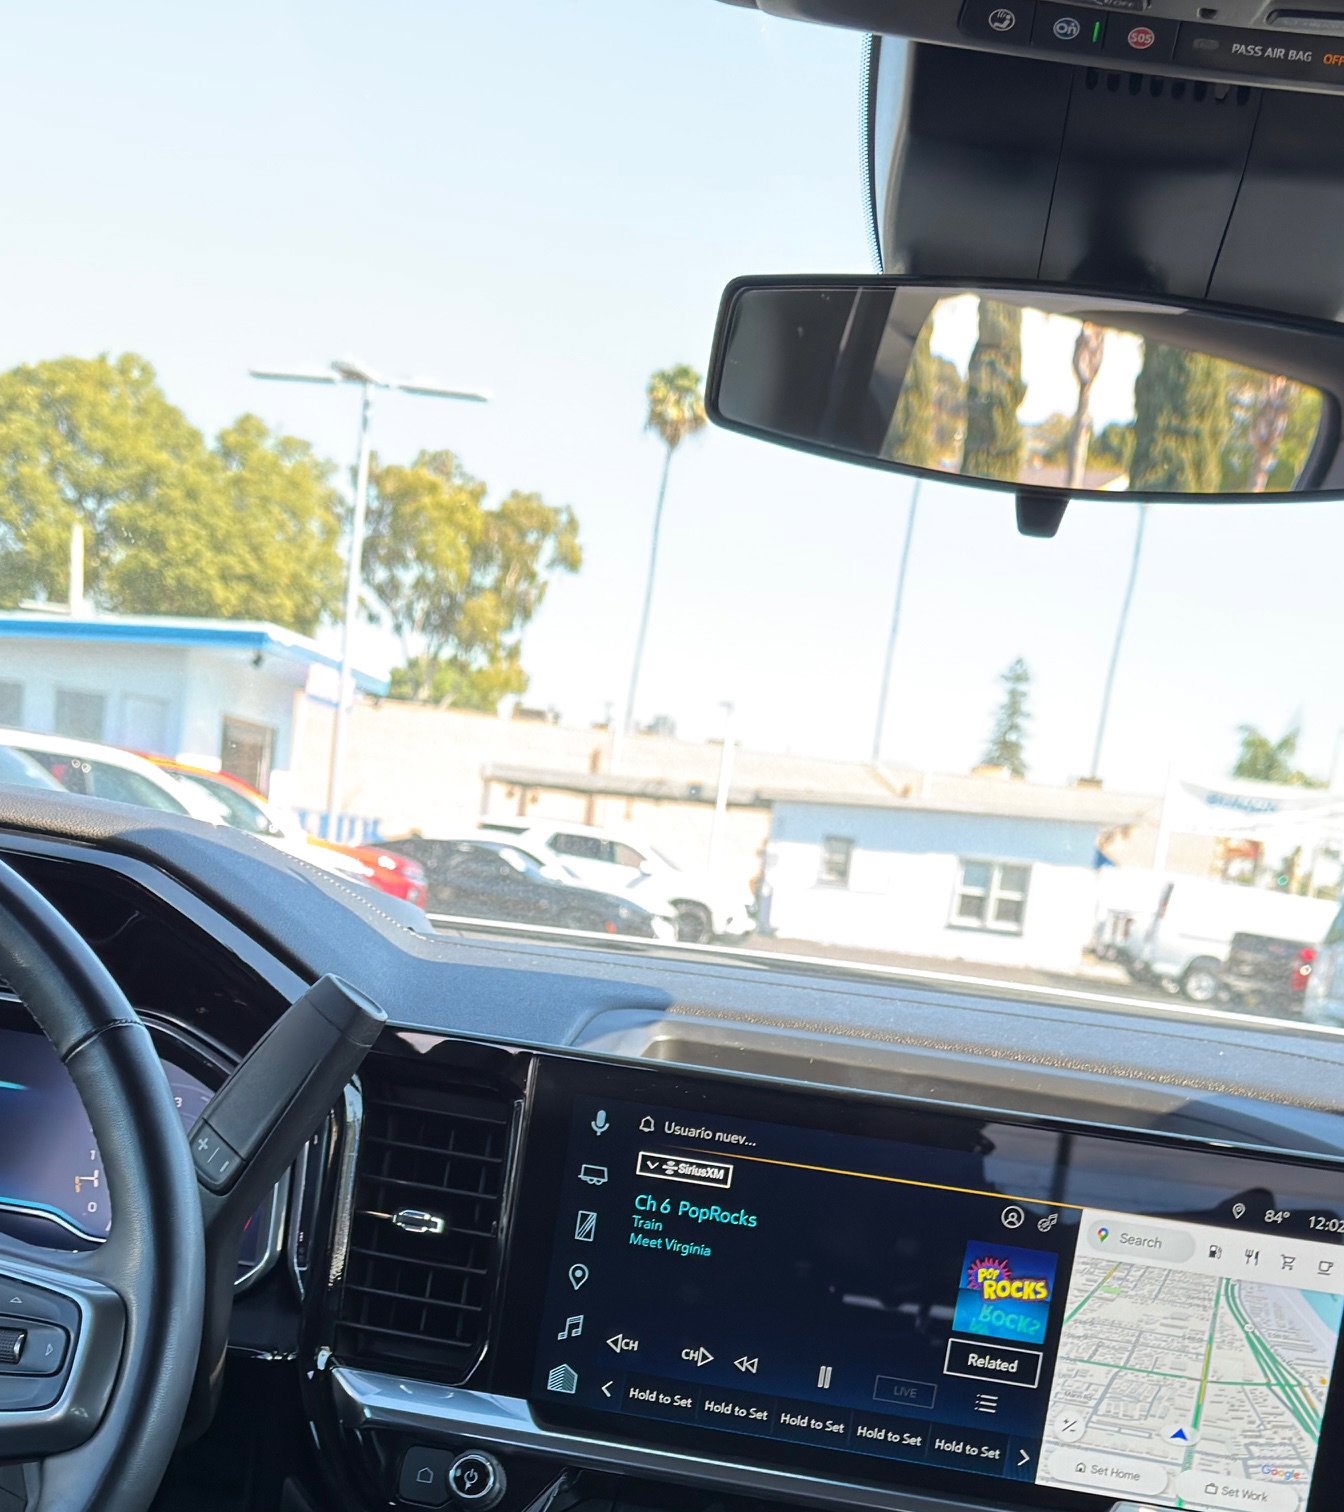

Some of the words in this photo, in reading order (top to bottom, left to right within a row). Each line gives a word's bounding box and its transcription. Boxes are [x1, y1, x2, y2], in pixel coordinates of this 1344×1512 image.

[1128, 31, 1155, 44] SOS
[1231, 42, 1263, 59] PASS
[1265, 46, 1287, 60] AIR
[1288, 48, 1313, 63] BAG
[664, 1121, 712, 1142] Usuario
[677, 1163, 724, 1181] SiriusXM
[634, 1194, 657, 1213] Ch
[659, 1198, 671, 1214] 6
[678, 1201, 757, 1229] PopRocks
[1264, 1208, 1291, 1225] 84°
[631, 1215, 663, 1232] Train
[629, 1233, 662, 1251] Meet
[665, 1238, 712, 1258] Virginia
[1119, 1232, 1163, 1250] Search
[977, 1267, 1000, 1283] POP
[983, 1279, 1048, 1300] ROCKS
[621, 1338, 639, 1351] CH
[681, 1349, 698, 1362] CH
[967, 1353, 1019, 1374] Related
[629, 1387, 657, 1404] Hold
[659, 1393, 671, 1405] to
[673, 1393, 693, 1409] Set
[893, 1385, 918, 1399] LIVE
[704, 1401, 732, 1417] Hold
[735, 1405, 746, 1418] to
[749, 1407, 768, 1422] Set
[780, 1413, 807, 1429] Hold
[810, 1418, 822, 1430] to
[824, 1418, 844, 1434] Set
[857, 1426, 884, 1442] Hold
[887, 1430, 898, 1443] to
[902, 1431, 922, 1448] Set
[934, 1438, 963, 1454] Hold
[965, 1443, 977, 1455] to
[979, 1444, 1000, 1461] Set
[1090, 1463, 1107, 1477] Set
[1110, 1465, 1141, 1482] Home
[1260, 1463, 1301, 1482] Google
[1221, 1485, 1239, 1499] Set
[1241, 1486, 1268, 1503] Work
